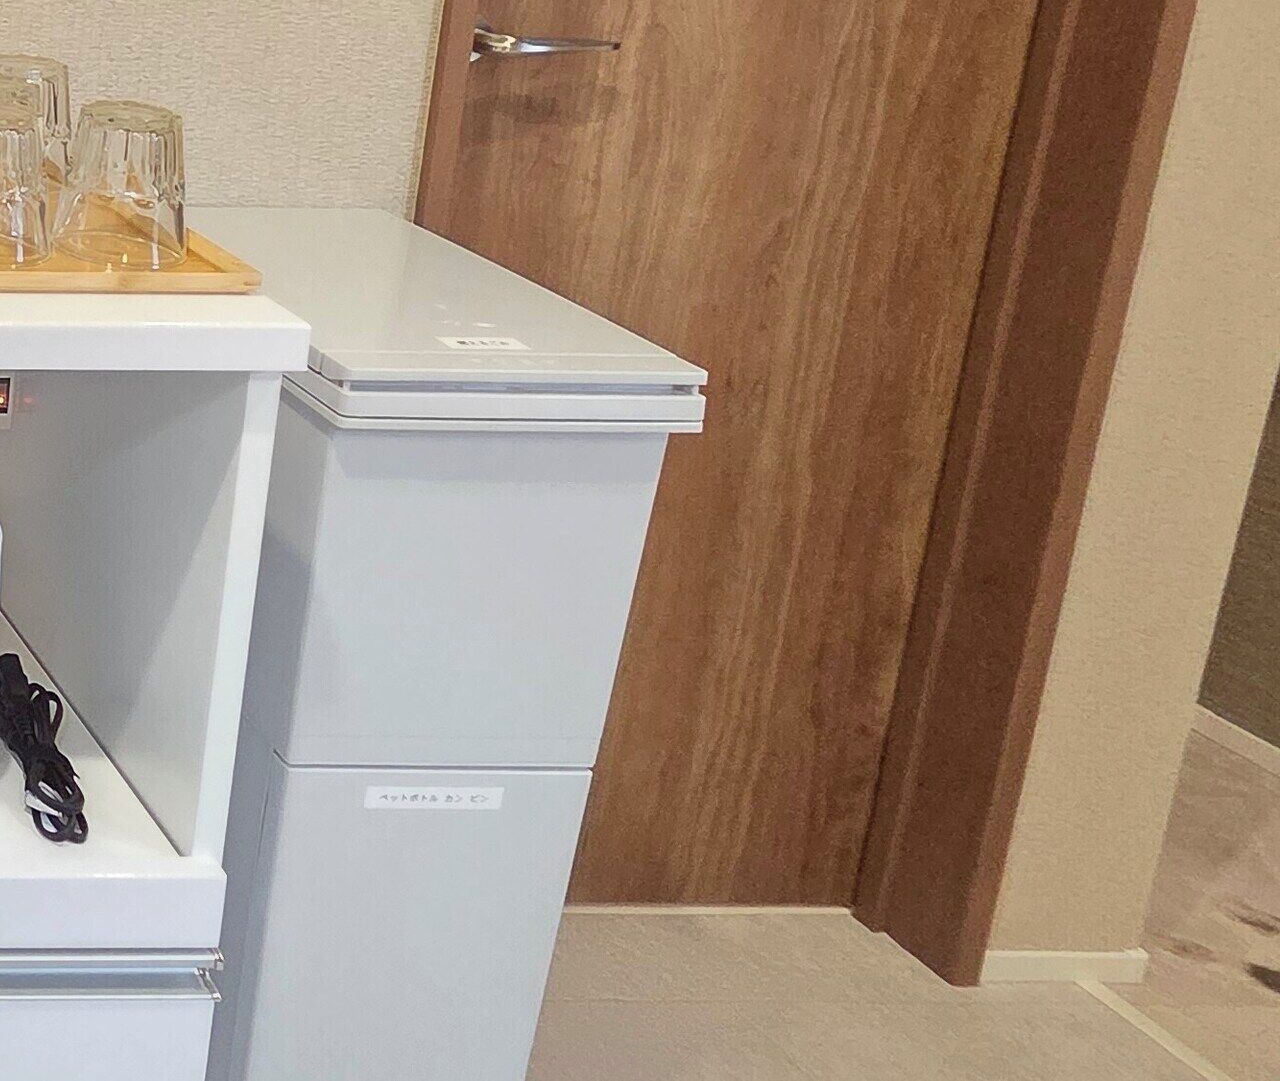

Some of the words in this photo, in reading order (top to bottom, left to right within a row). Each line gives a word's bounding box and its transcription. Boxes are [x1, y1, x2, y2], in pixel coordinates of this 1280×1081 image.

[378, 793, 439, 803] ペットボトル
[445, 793, 463, 803] カン
